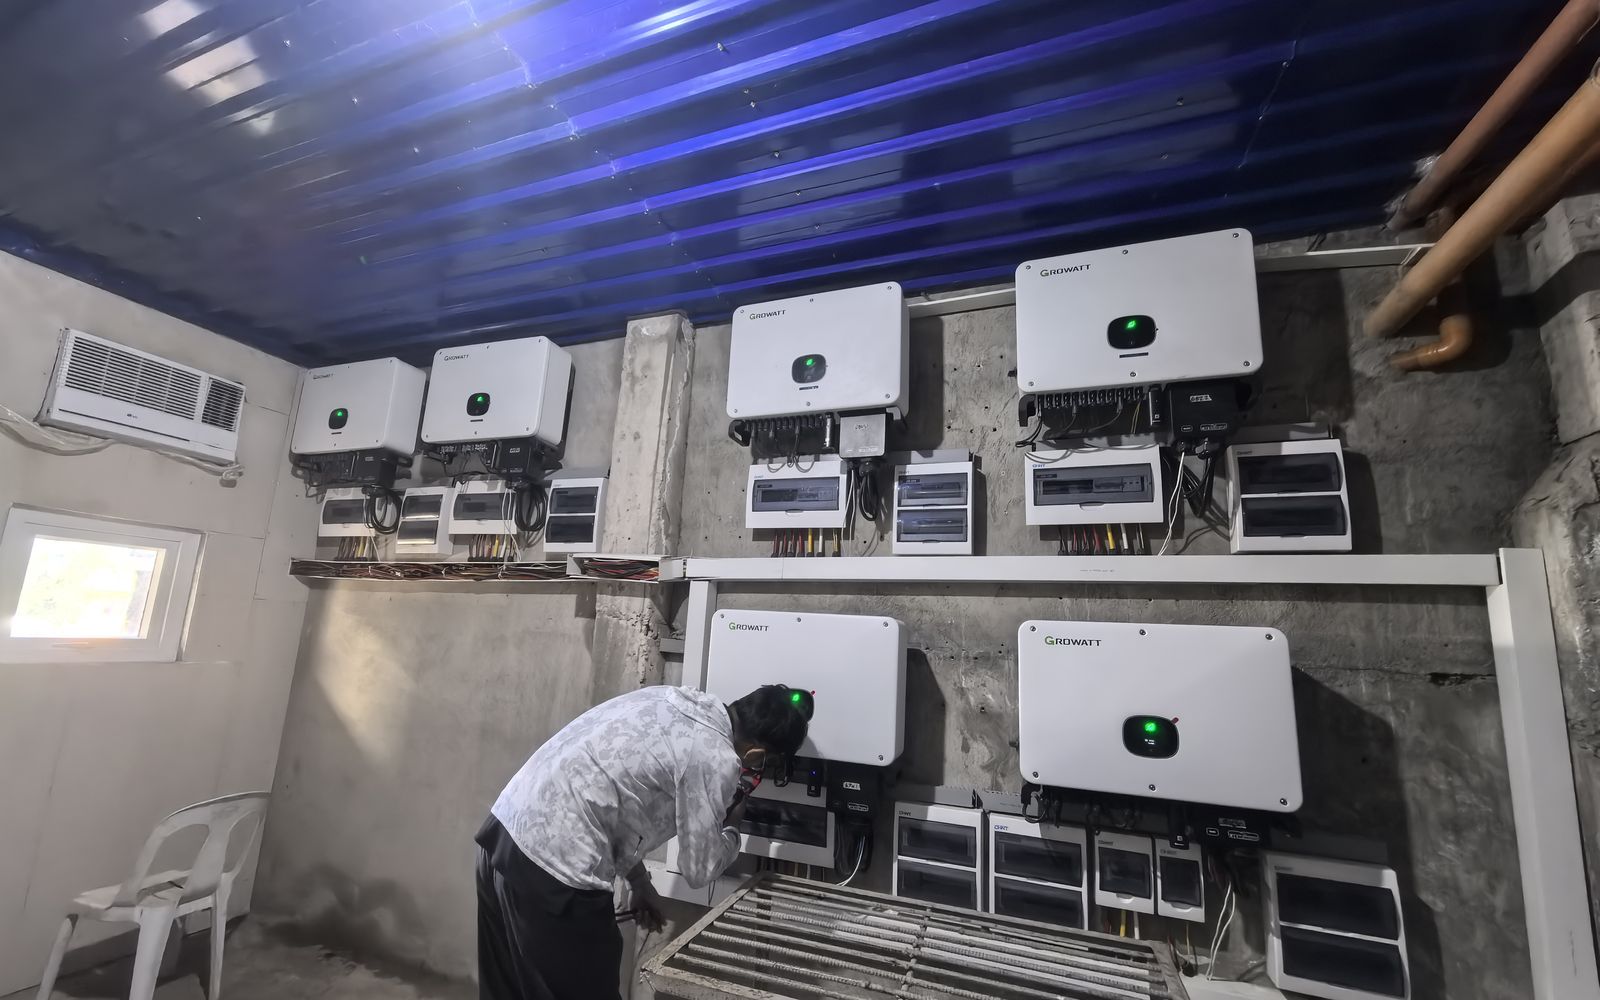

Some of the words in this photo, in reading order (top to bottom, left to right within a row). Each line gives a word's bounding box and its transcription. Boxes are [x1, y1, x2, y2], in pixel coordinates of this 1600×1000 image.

[1040, 263, 1091, 277] GROWATT
[749, 309, 786, 320] GROWATT
[728, 622, 769, 632] GROWATT
[1044, 635, 1102, 647] GROWATT
